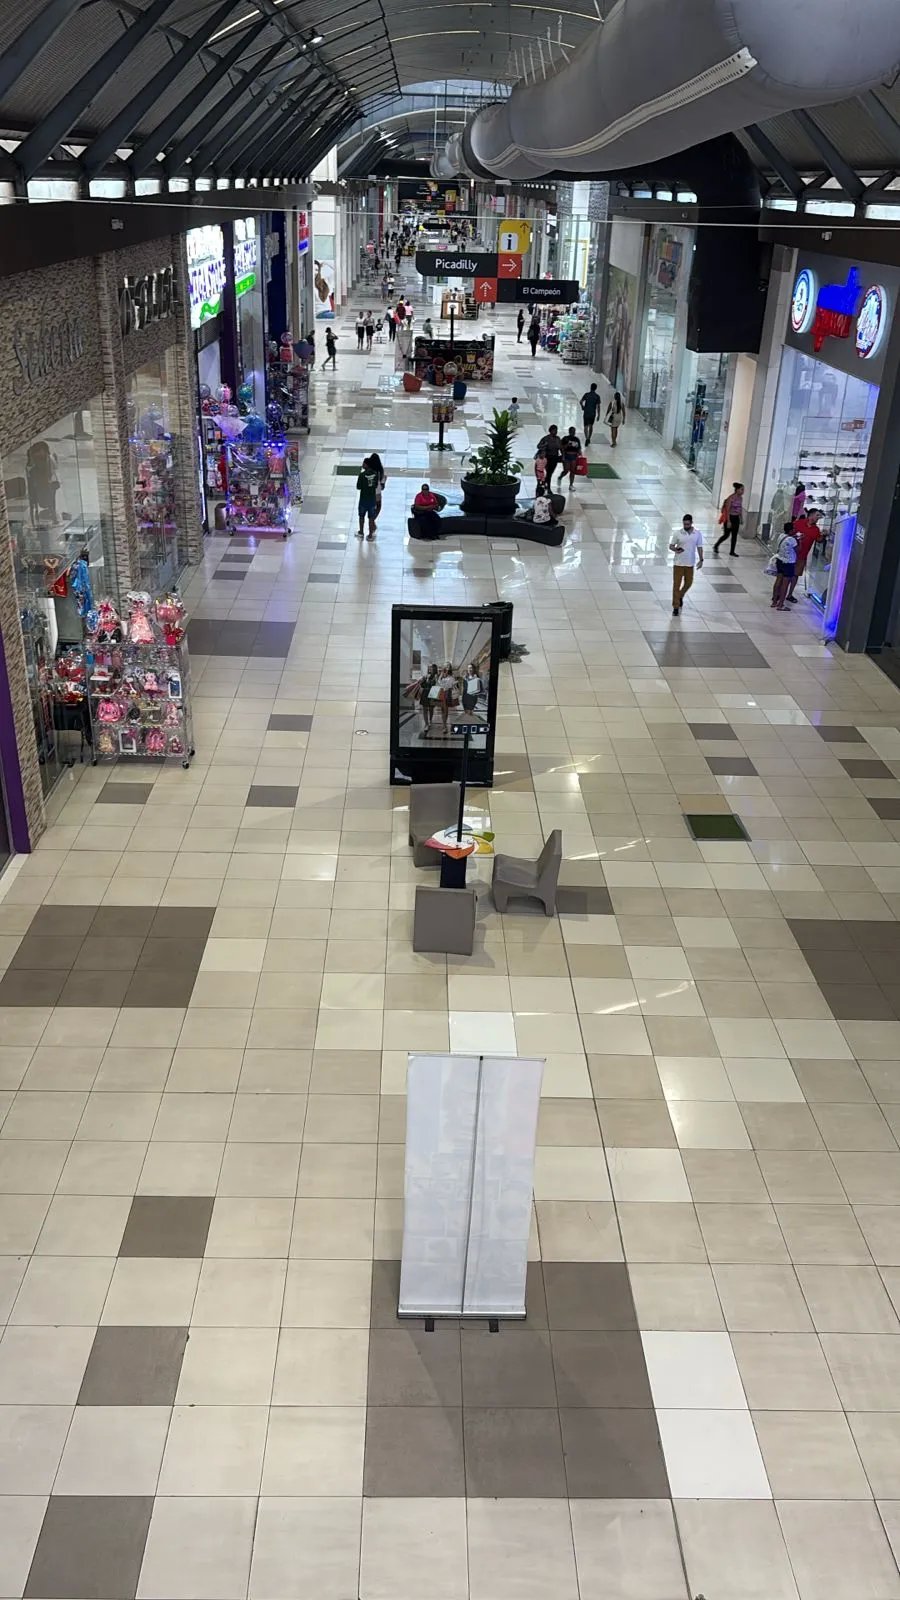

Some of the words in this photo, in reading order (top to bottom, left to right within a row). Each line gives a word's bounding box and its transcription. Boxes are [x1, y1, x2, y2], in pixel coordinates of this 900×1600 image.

[507, 234, 512, 250] i
[435, 258, 478, 272] Picadilly
[530, 287, 561, 296] Campeón
